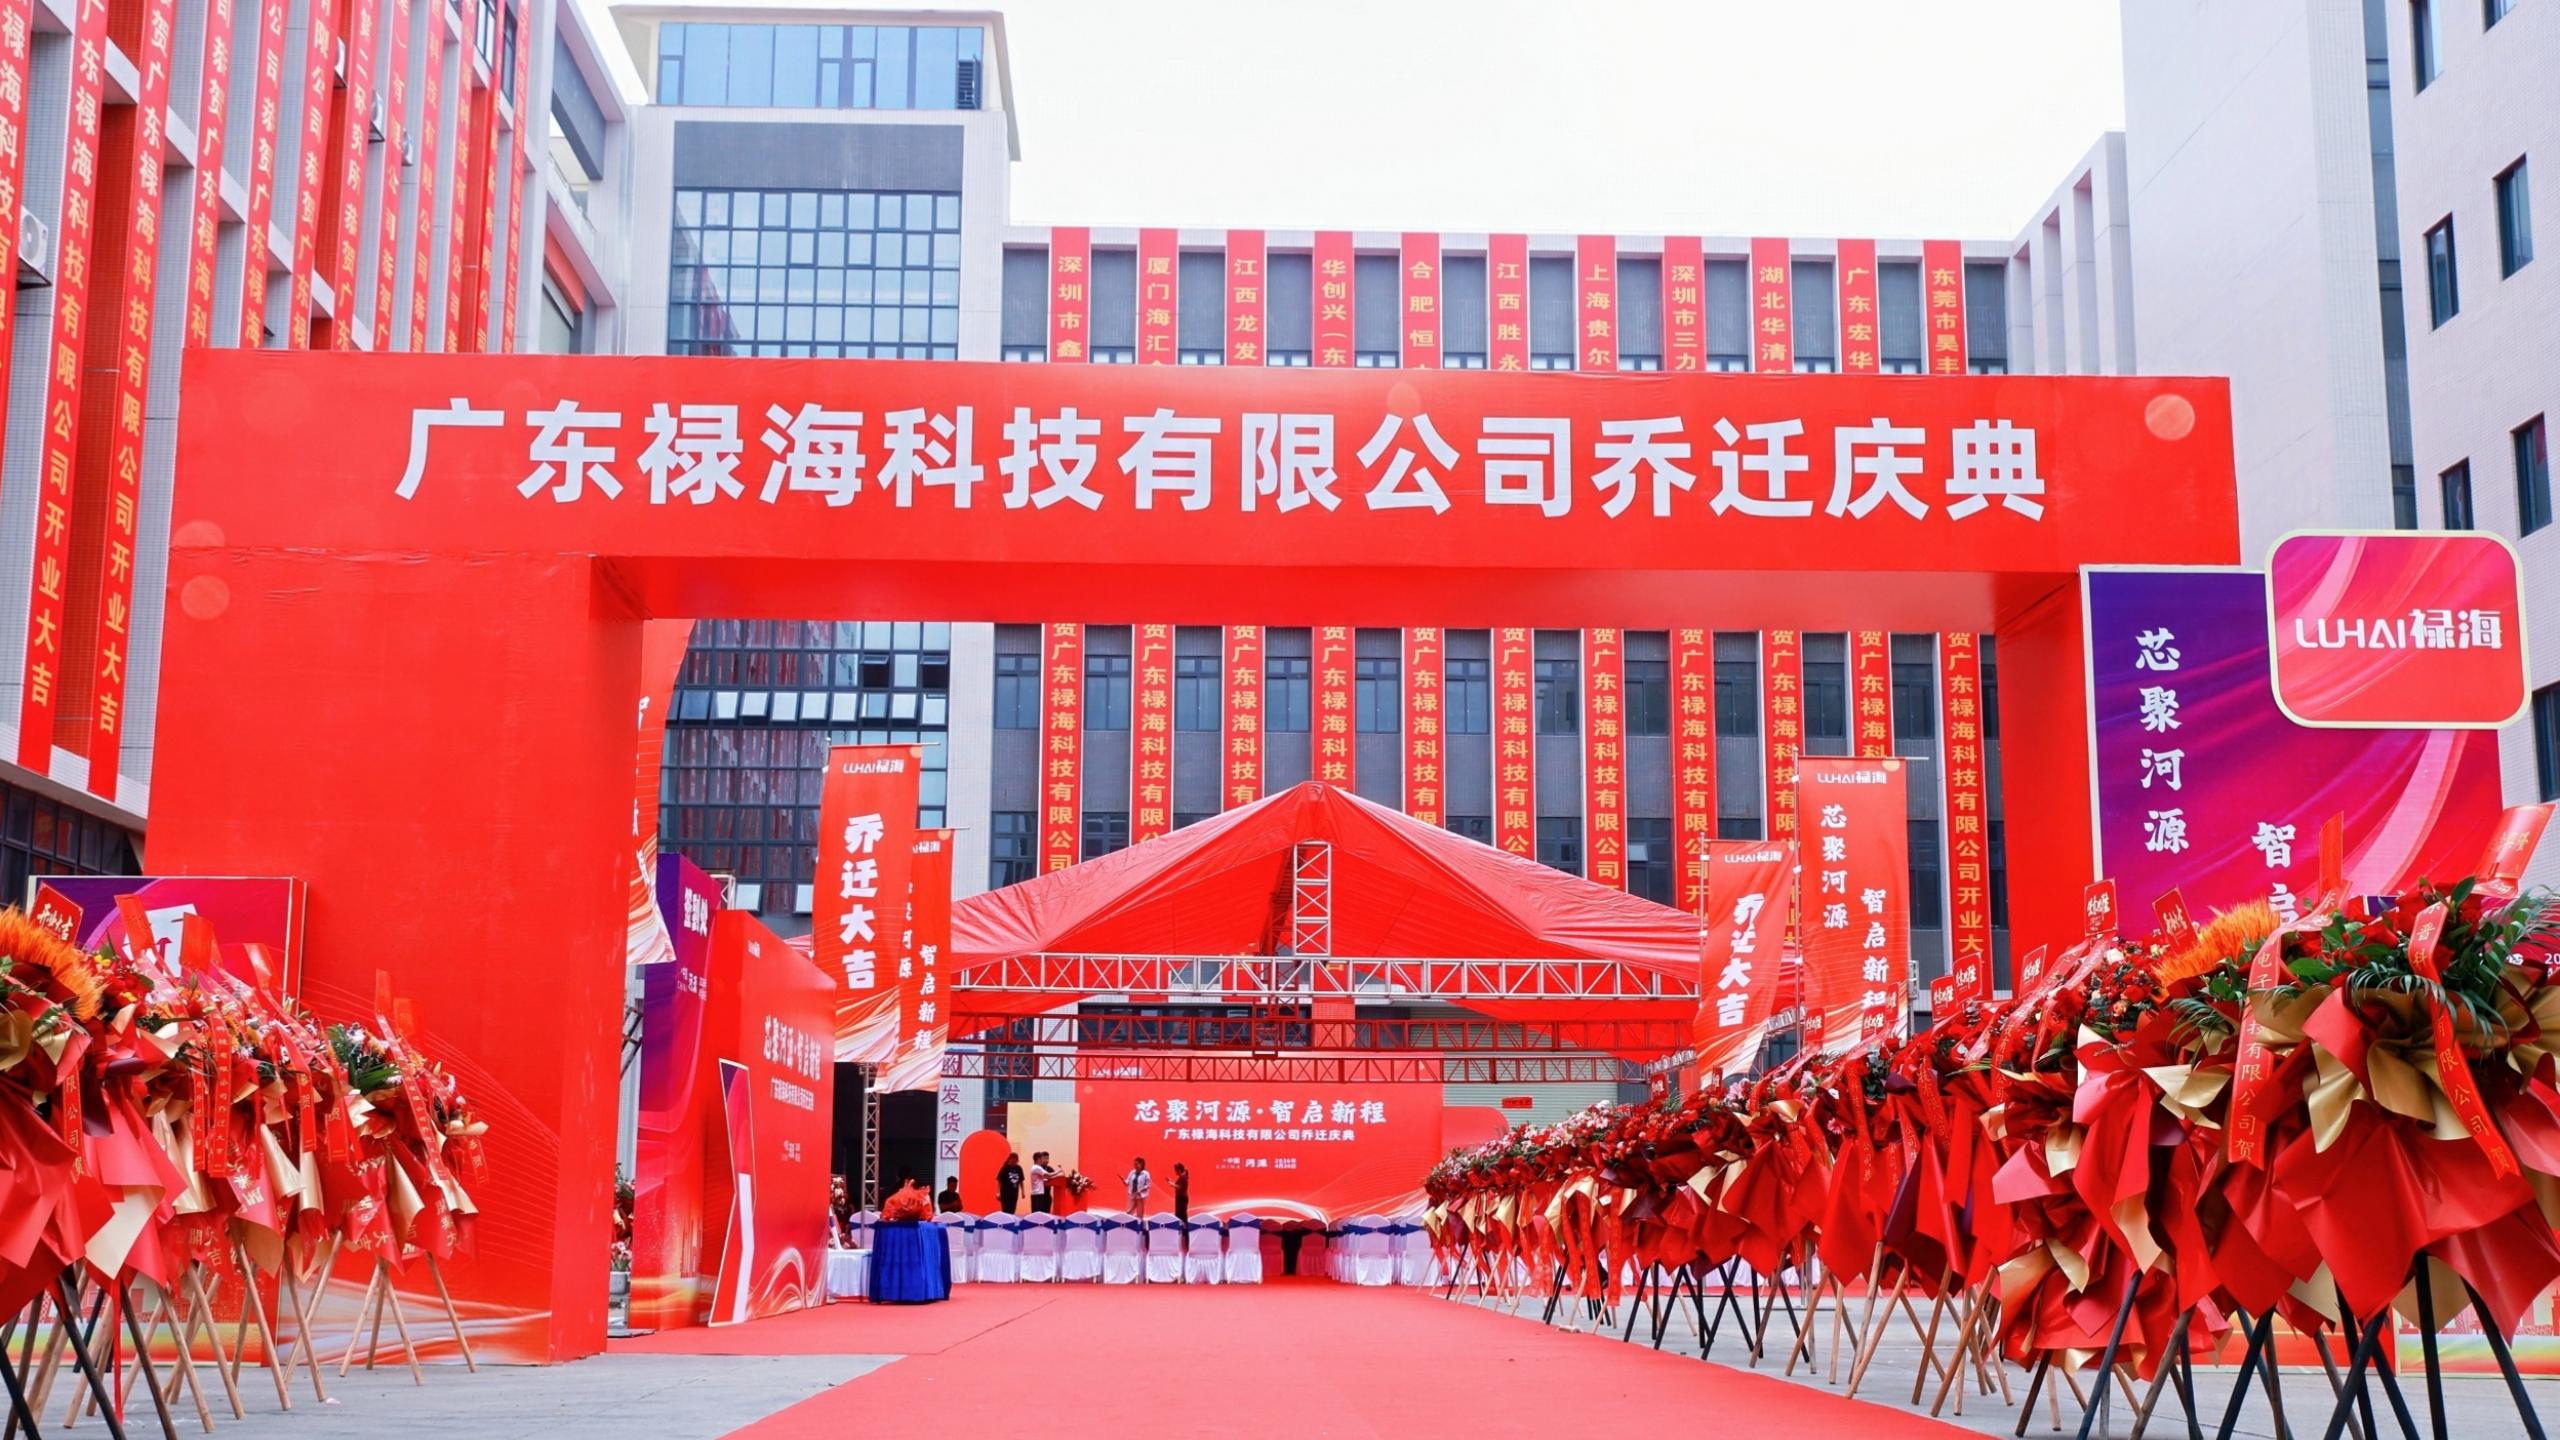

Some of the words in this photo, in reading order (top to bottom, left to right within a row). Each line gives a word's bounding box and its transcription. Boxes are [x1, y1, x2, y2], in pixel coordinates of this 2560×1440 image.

[1056, 255, 1083, 358] 深圳市鑫
[1146, 257, 1171, 365] 厦门海汇
[1233, 259, 1259, 360] 江西龙发
[1409, 261, 1435, 369] 合肥恒
[1496, 263, 1522, 371] 江西胜永
[1585, 264, 1611, 366] 上海贵尔
[1671, 265, 1698, 371] 深圳市三力
[1759, 266, 1787, 373] 湖北华清
[1846, 267, 1874, 369] 广东宏华
[99, 0, 170, 734] 贺广东禄海科技有限公司开业大吉
[394, 397, 2047, 522] 广东禄海科技有限公司乔迁庆典
[1592, 629, 1620, 892] 贺广东禄海科技有限公司
[2135, 627, 2190, 854] 芯聚河源
[840, 813, 884, 990] 乔迁大吉
[1820, 804, 1849, 929] 芯聚河源
[914, 944, 937, 1050] 智启新程
[1163, 1128, 1355, 1141] 广东禄海科技有限公司乔迁庆典
